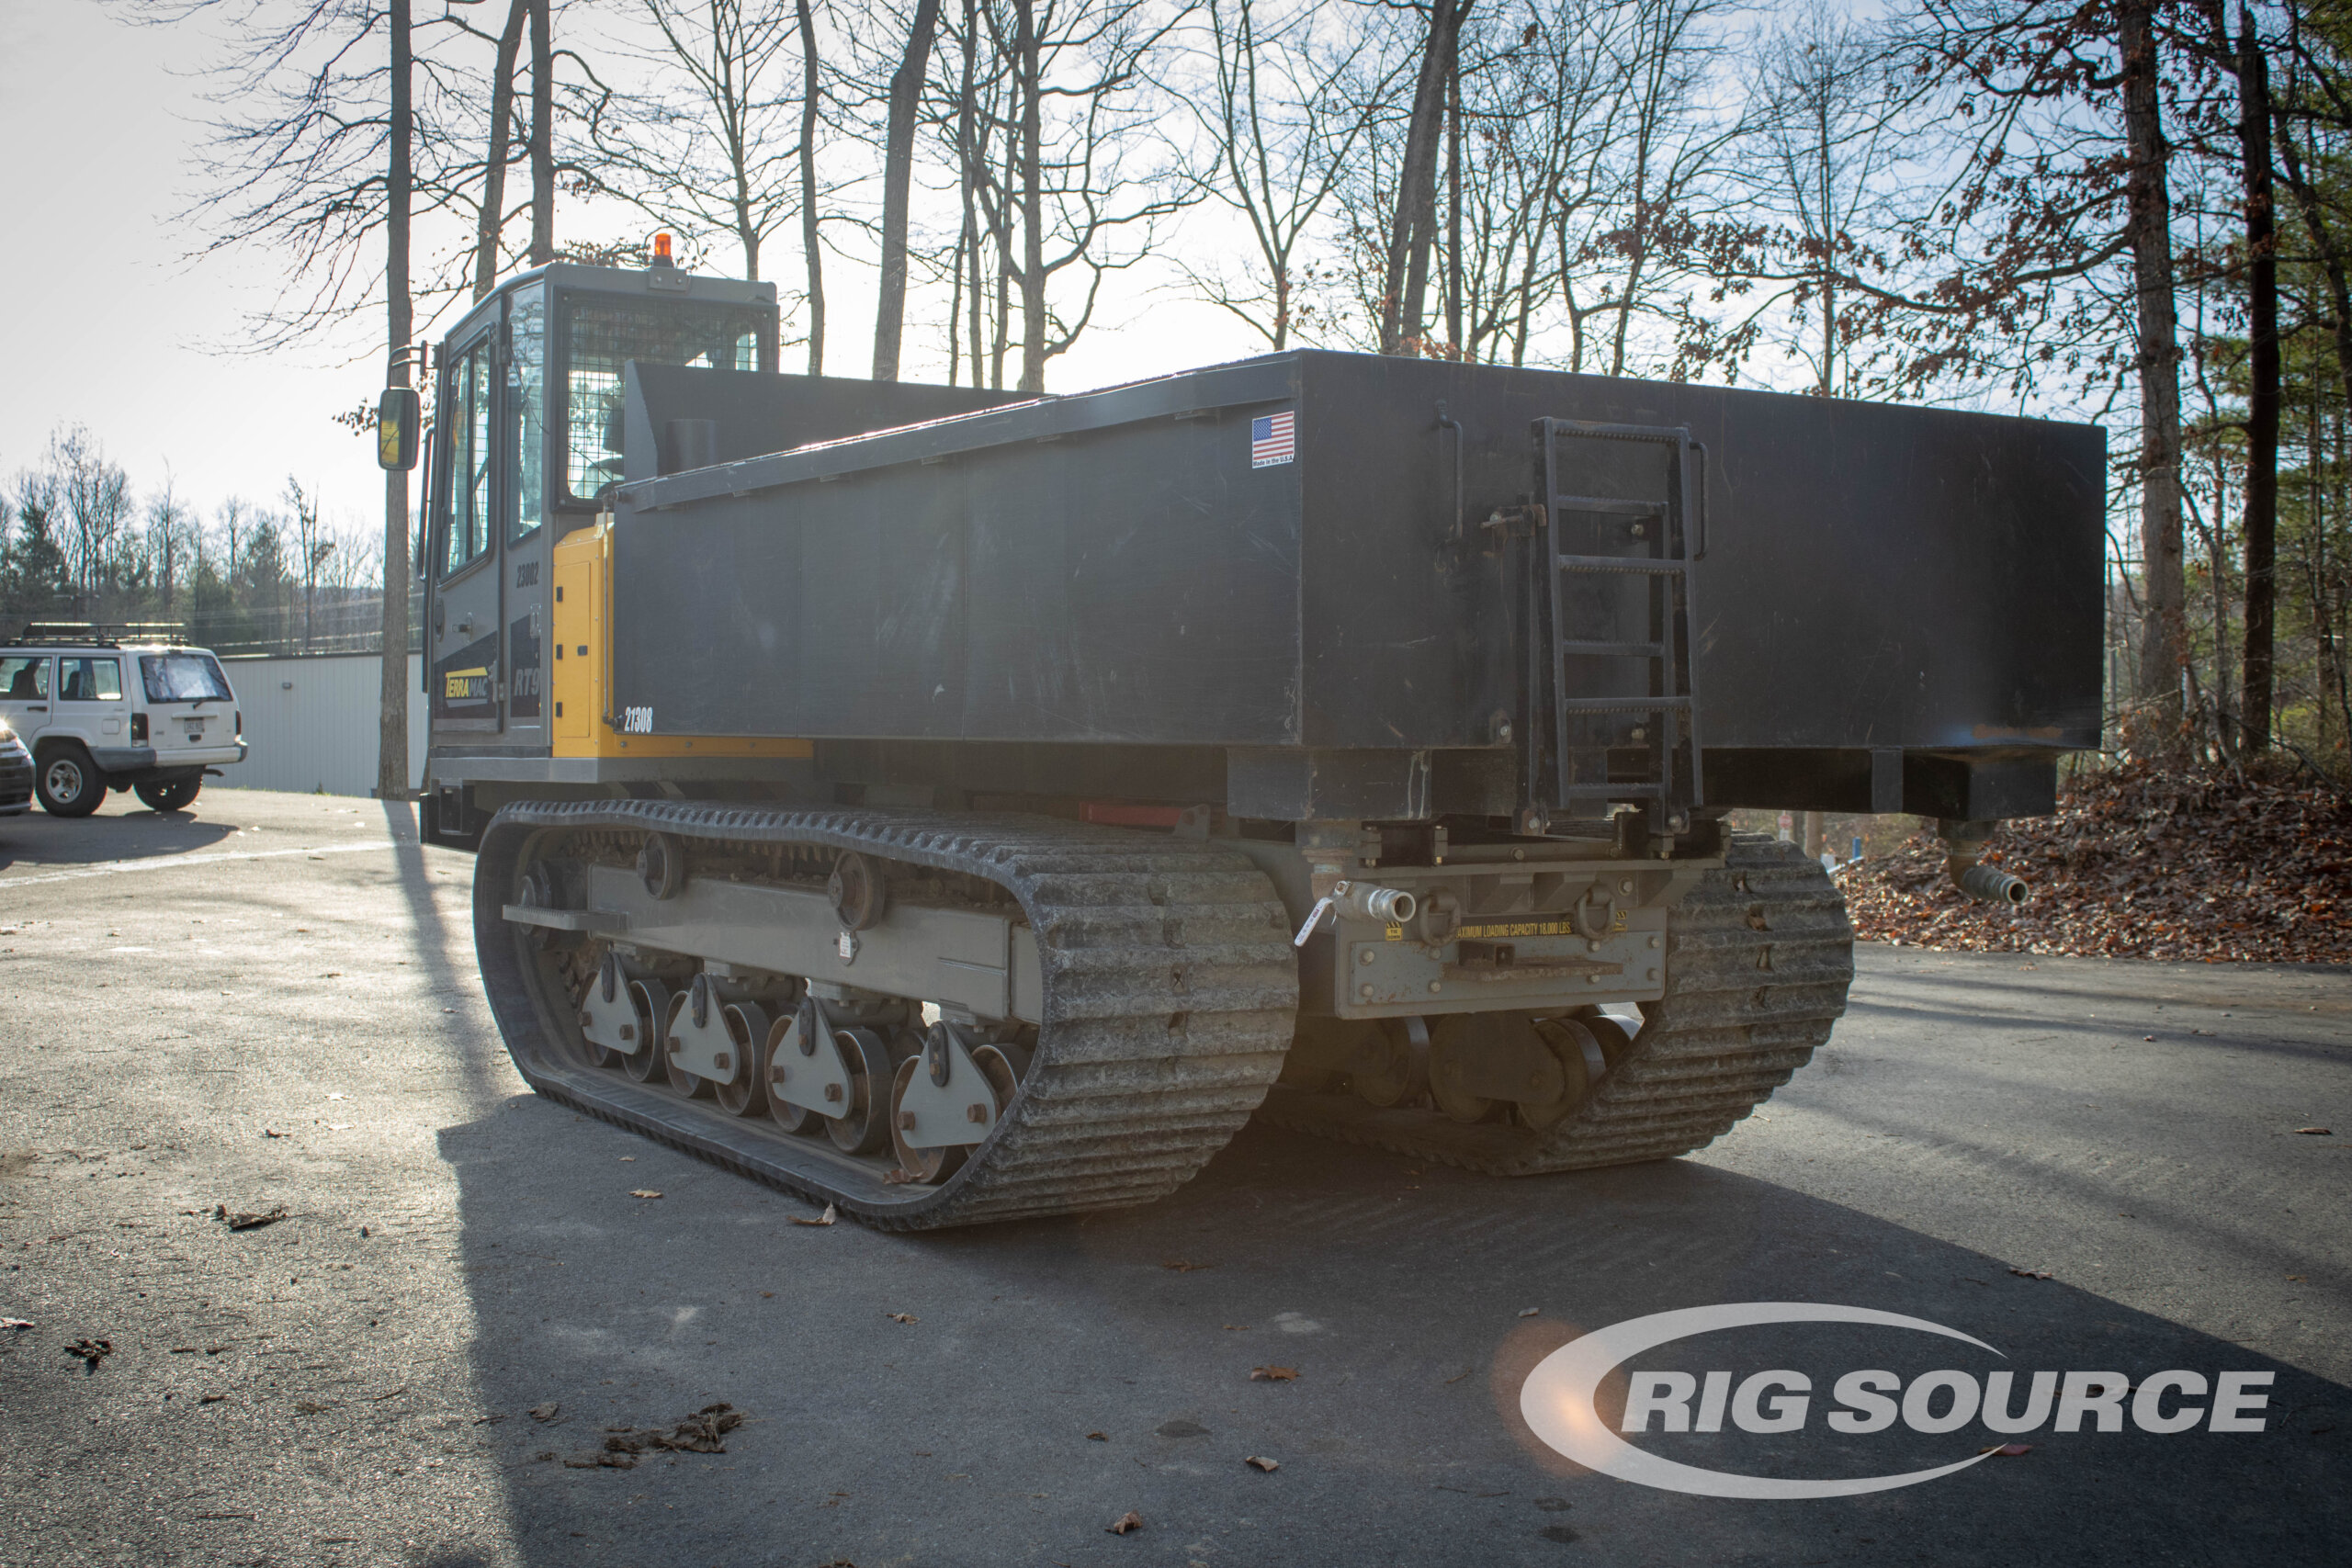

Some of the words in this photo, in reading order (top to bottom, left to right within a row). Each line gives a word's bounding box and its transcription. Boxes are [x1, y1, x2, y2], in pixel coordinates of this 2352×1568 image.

[516, 561, 539, 588] 23002
[446, 667, 488, 698] TERRAMAC
[514, 668, 540, 696] RT9
[625, 706, 653, 733] 21308
[1456, 926, 1482, 939] AXIMUM
[1484, 924, 1509, 937] LOADING
[1510, 923, 1538, 936] CAPACITY
